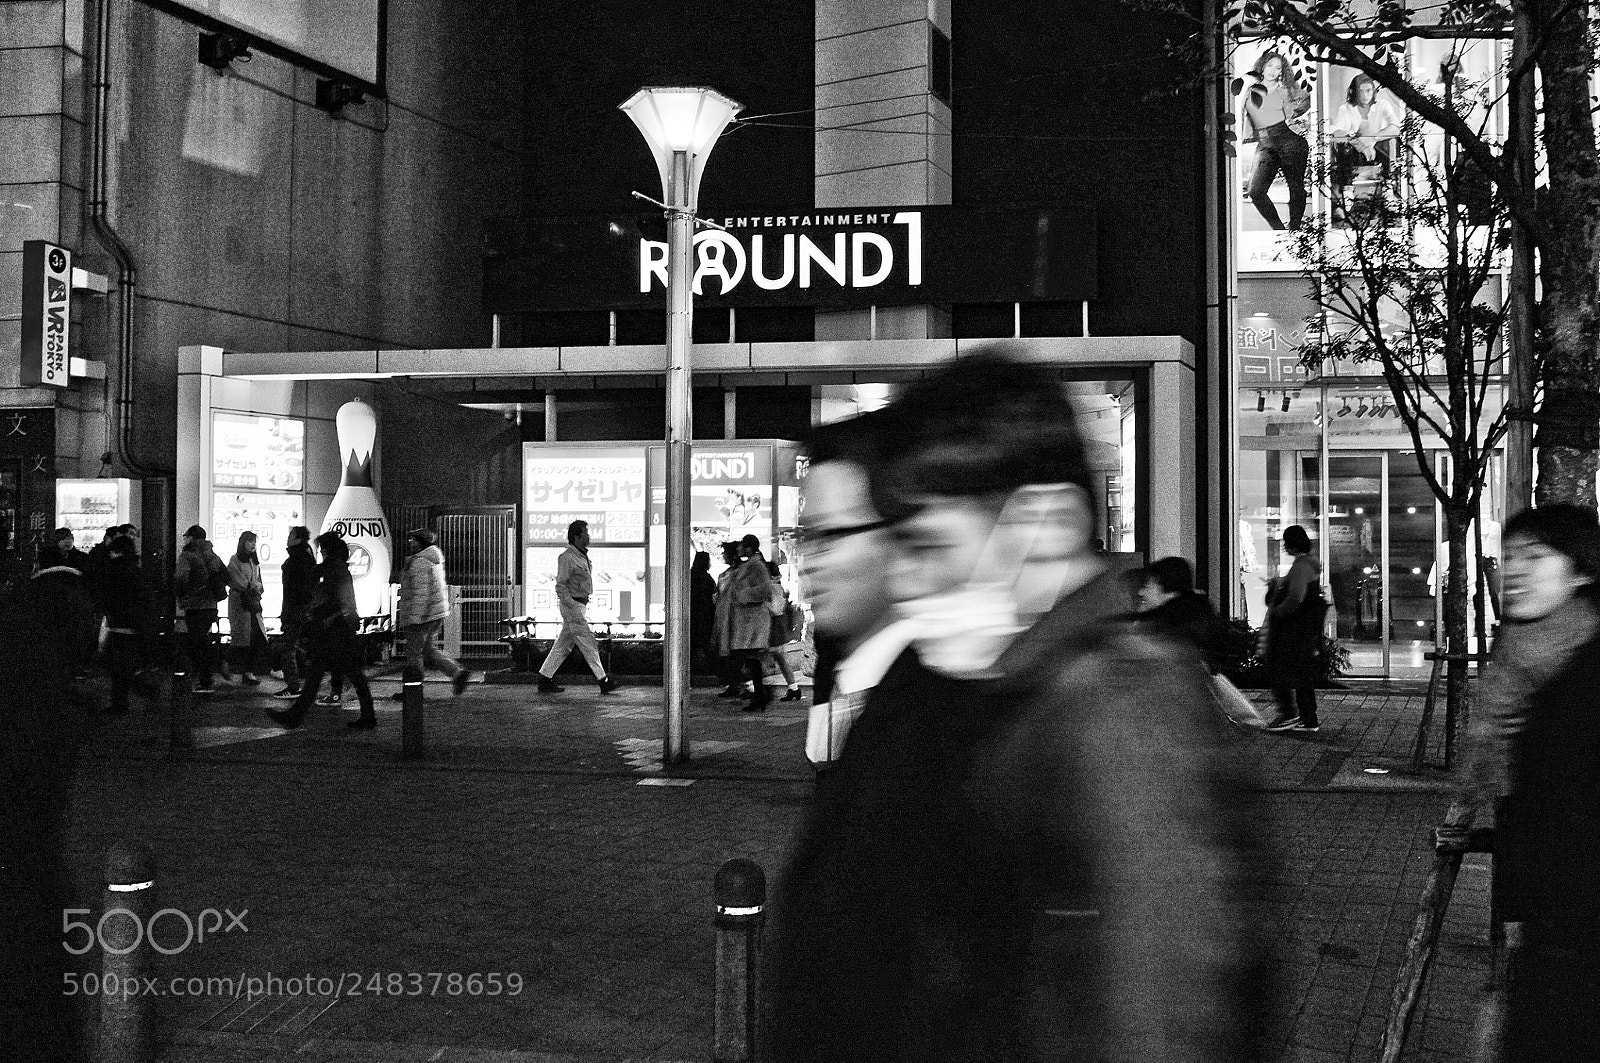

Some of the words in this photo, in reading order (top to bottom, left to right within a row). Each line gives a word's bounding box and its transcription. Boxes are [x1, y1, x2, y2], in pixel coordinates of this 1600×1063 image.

[724, 213, 891, 228] ENTERTAINMENT
[51, 254, 64, 268] 3F
[47, 306, 65, 335] VR
[46, 333, 55, 380] TOKYO
[54, 335, 64, 372] PARK
[530, 478, 643, 503] サイゼリヤ
